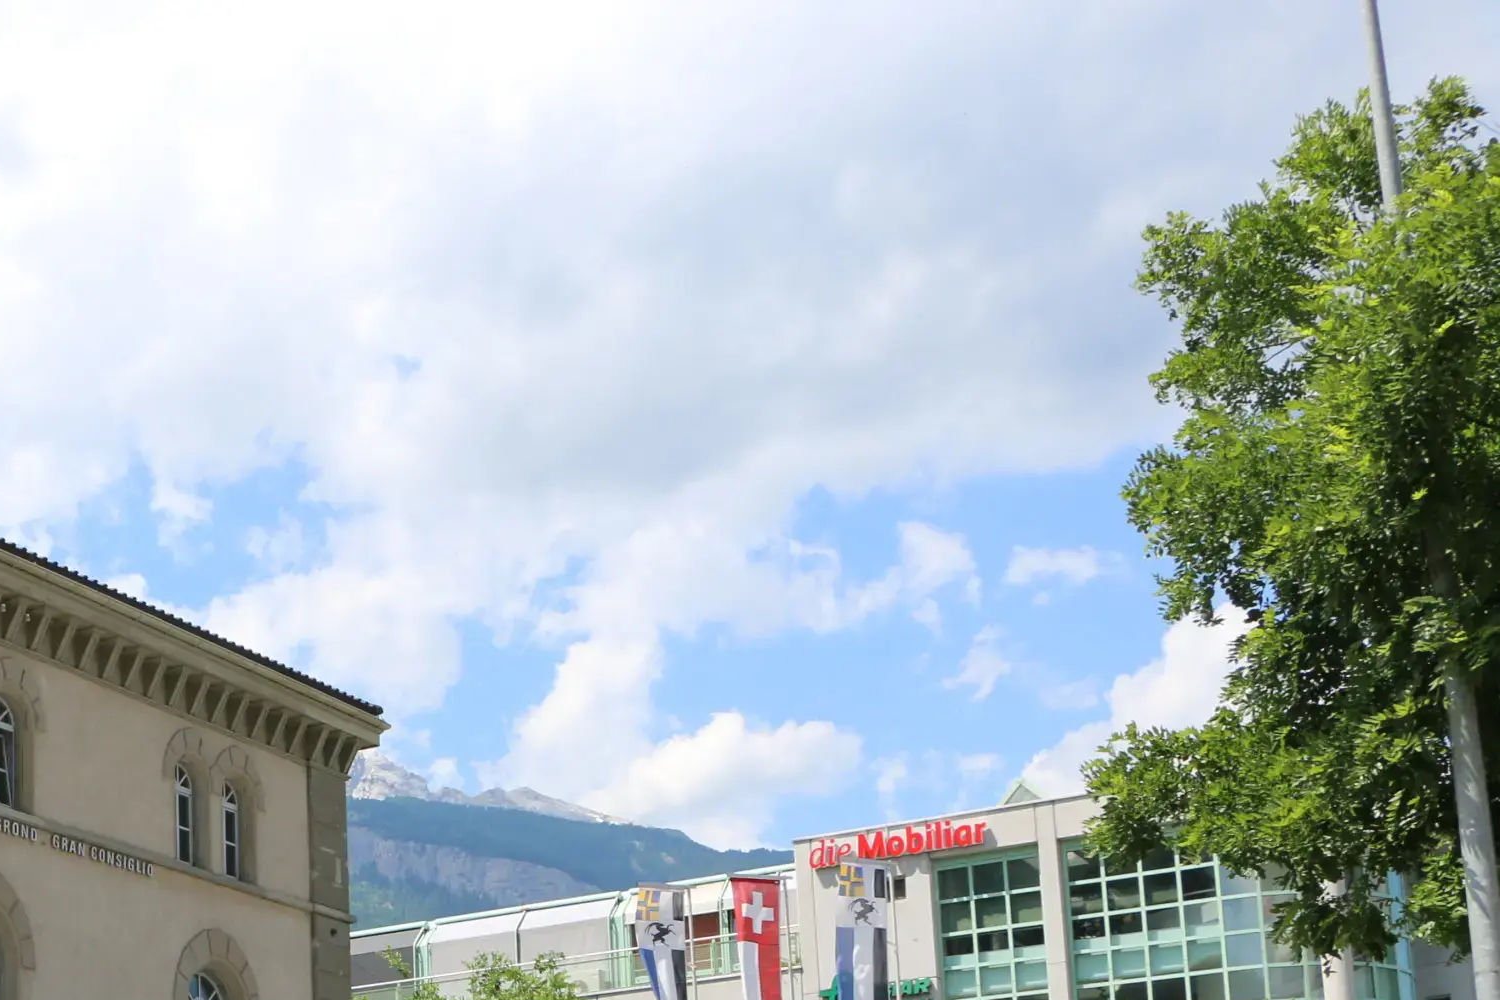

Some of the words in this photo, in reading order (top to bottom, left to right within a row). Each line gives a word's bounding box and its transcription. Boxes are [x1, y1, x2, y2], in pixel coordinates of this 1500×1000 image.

[51, 834, 86, 857] GRAN
[90, 846, 155, 877] CONSIGLIO
[809, 838, 851, 869] die
[856, 819, 987, 860] Mobiliar
